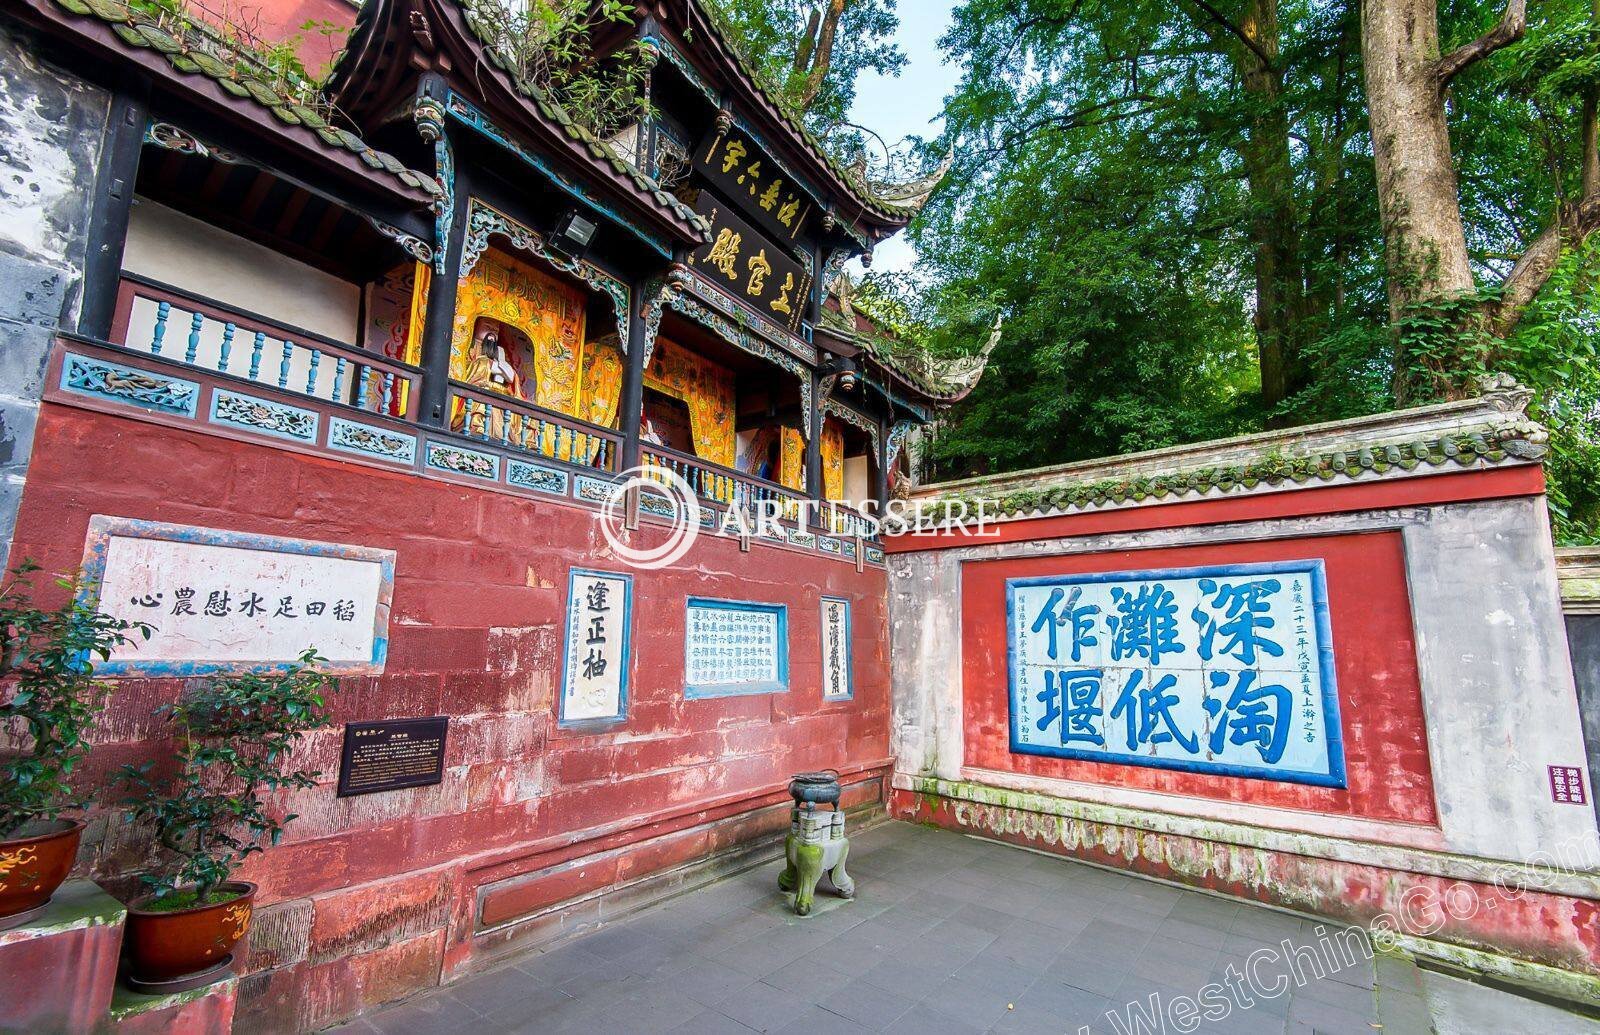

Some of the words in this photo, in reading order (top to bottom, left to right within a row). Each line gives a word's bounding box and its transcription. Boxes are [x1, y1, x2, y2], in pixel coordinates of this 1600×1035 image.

[131, 586, 356, 622] 稻田足水慰農心
[1031, 586, 1105, 746] 作堰
[1191, 578, 1294, 765] 深淘
